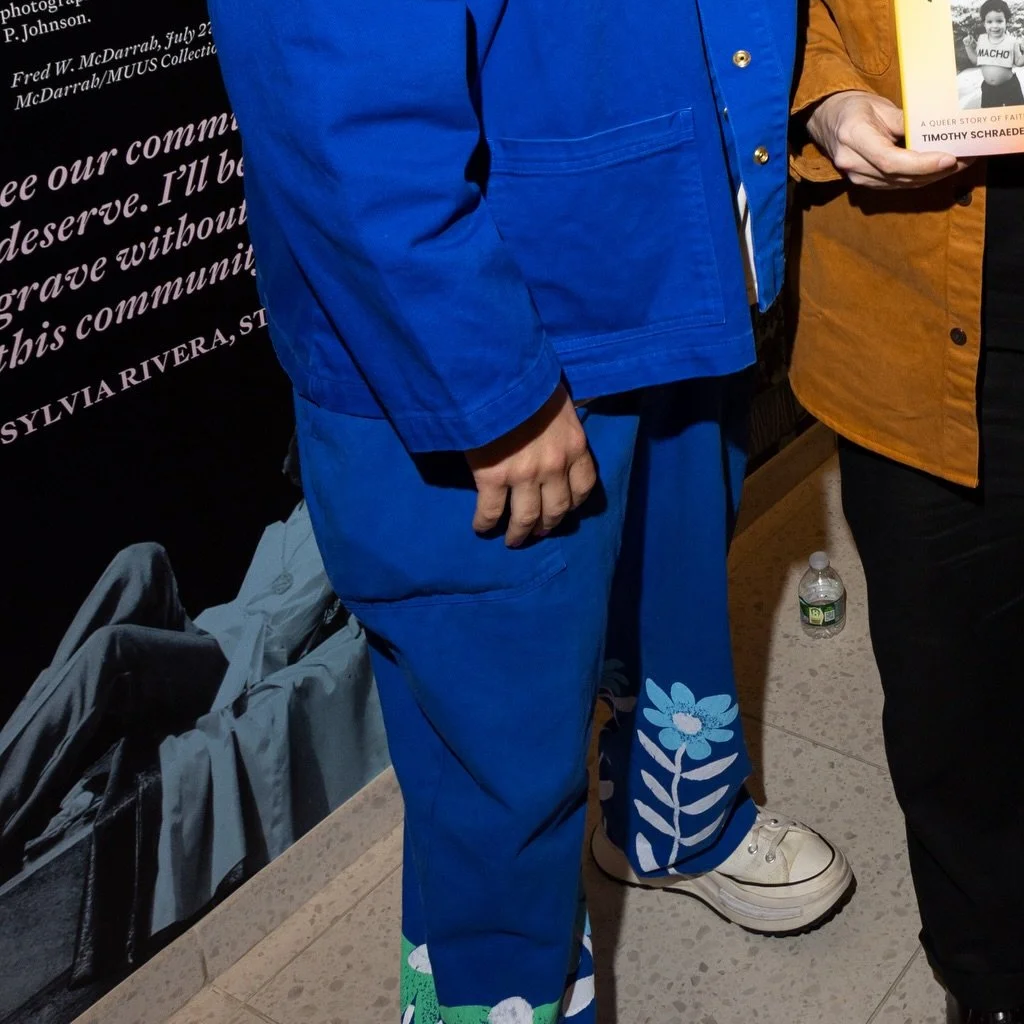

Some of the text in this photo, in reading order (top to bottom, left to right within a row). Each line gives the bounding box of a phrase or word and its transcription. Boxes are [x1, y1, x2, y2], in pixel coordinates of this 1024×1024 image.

[3, 12, 92, 43] P. Johnson.
[977, 48, 1010, 59] MACHO
[10, 63, 51, 88] Fred
[55, 58, 75, 76] W.
[78, 36, 162, 70] McDarrah,
[164, 26, 196, 50] July
[14, 58, 157, 111] McDarrah/MUUS
[922, 132, 968, 143] TIMOTHY
[929, 119, 957, 128] QUEER
[959, 116, 987, 125] STORY
[990, 115, 1001, 123] OF
[48, 149, 117, 191] our
[0, 192, 148, 265] deserve.
[0, 198, 248, 327] grave without
[0, 242, 256, 372] this communit
[1, 379, 116, 445] SYLVIA
[118, 327, 236, 391] RIVERA,
